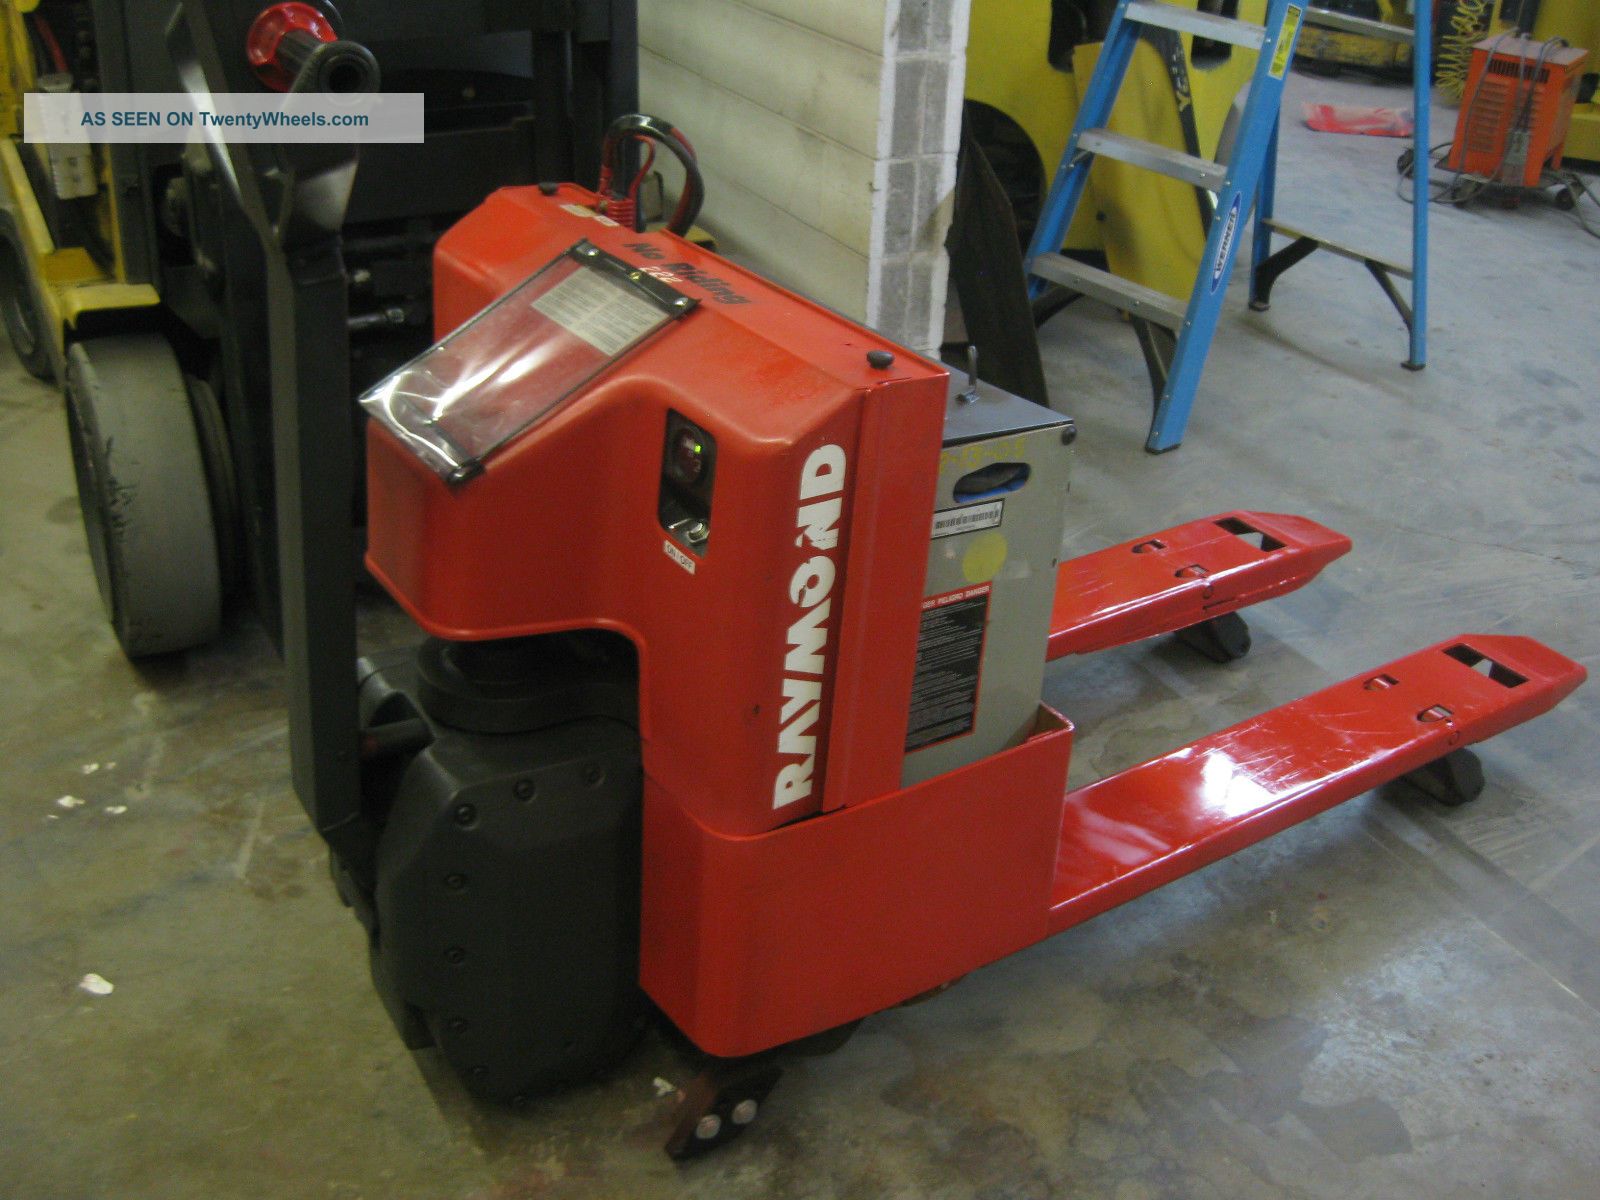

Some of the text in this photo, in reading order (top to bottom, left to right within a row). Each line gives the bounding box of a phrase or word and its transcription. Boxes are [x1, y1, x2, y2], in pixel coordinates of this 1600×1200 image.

[1213, 210, 1237, 272] WERNER
[965, 585, 990, 598] DANGER
[772, 443, 847, 810] RAYMOND
